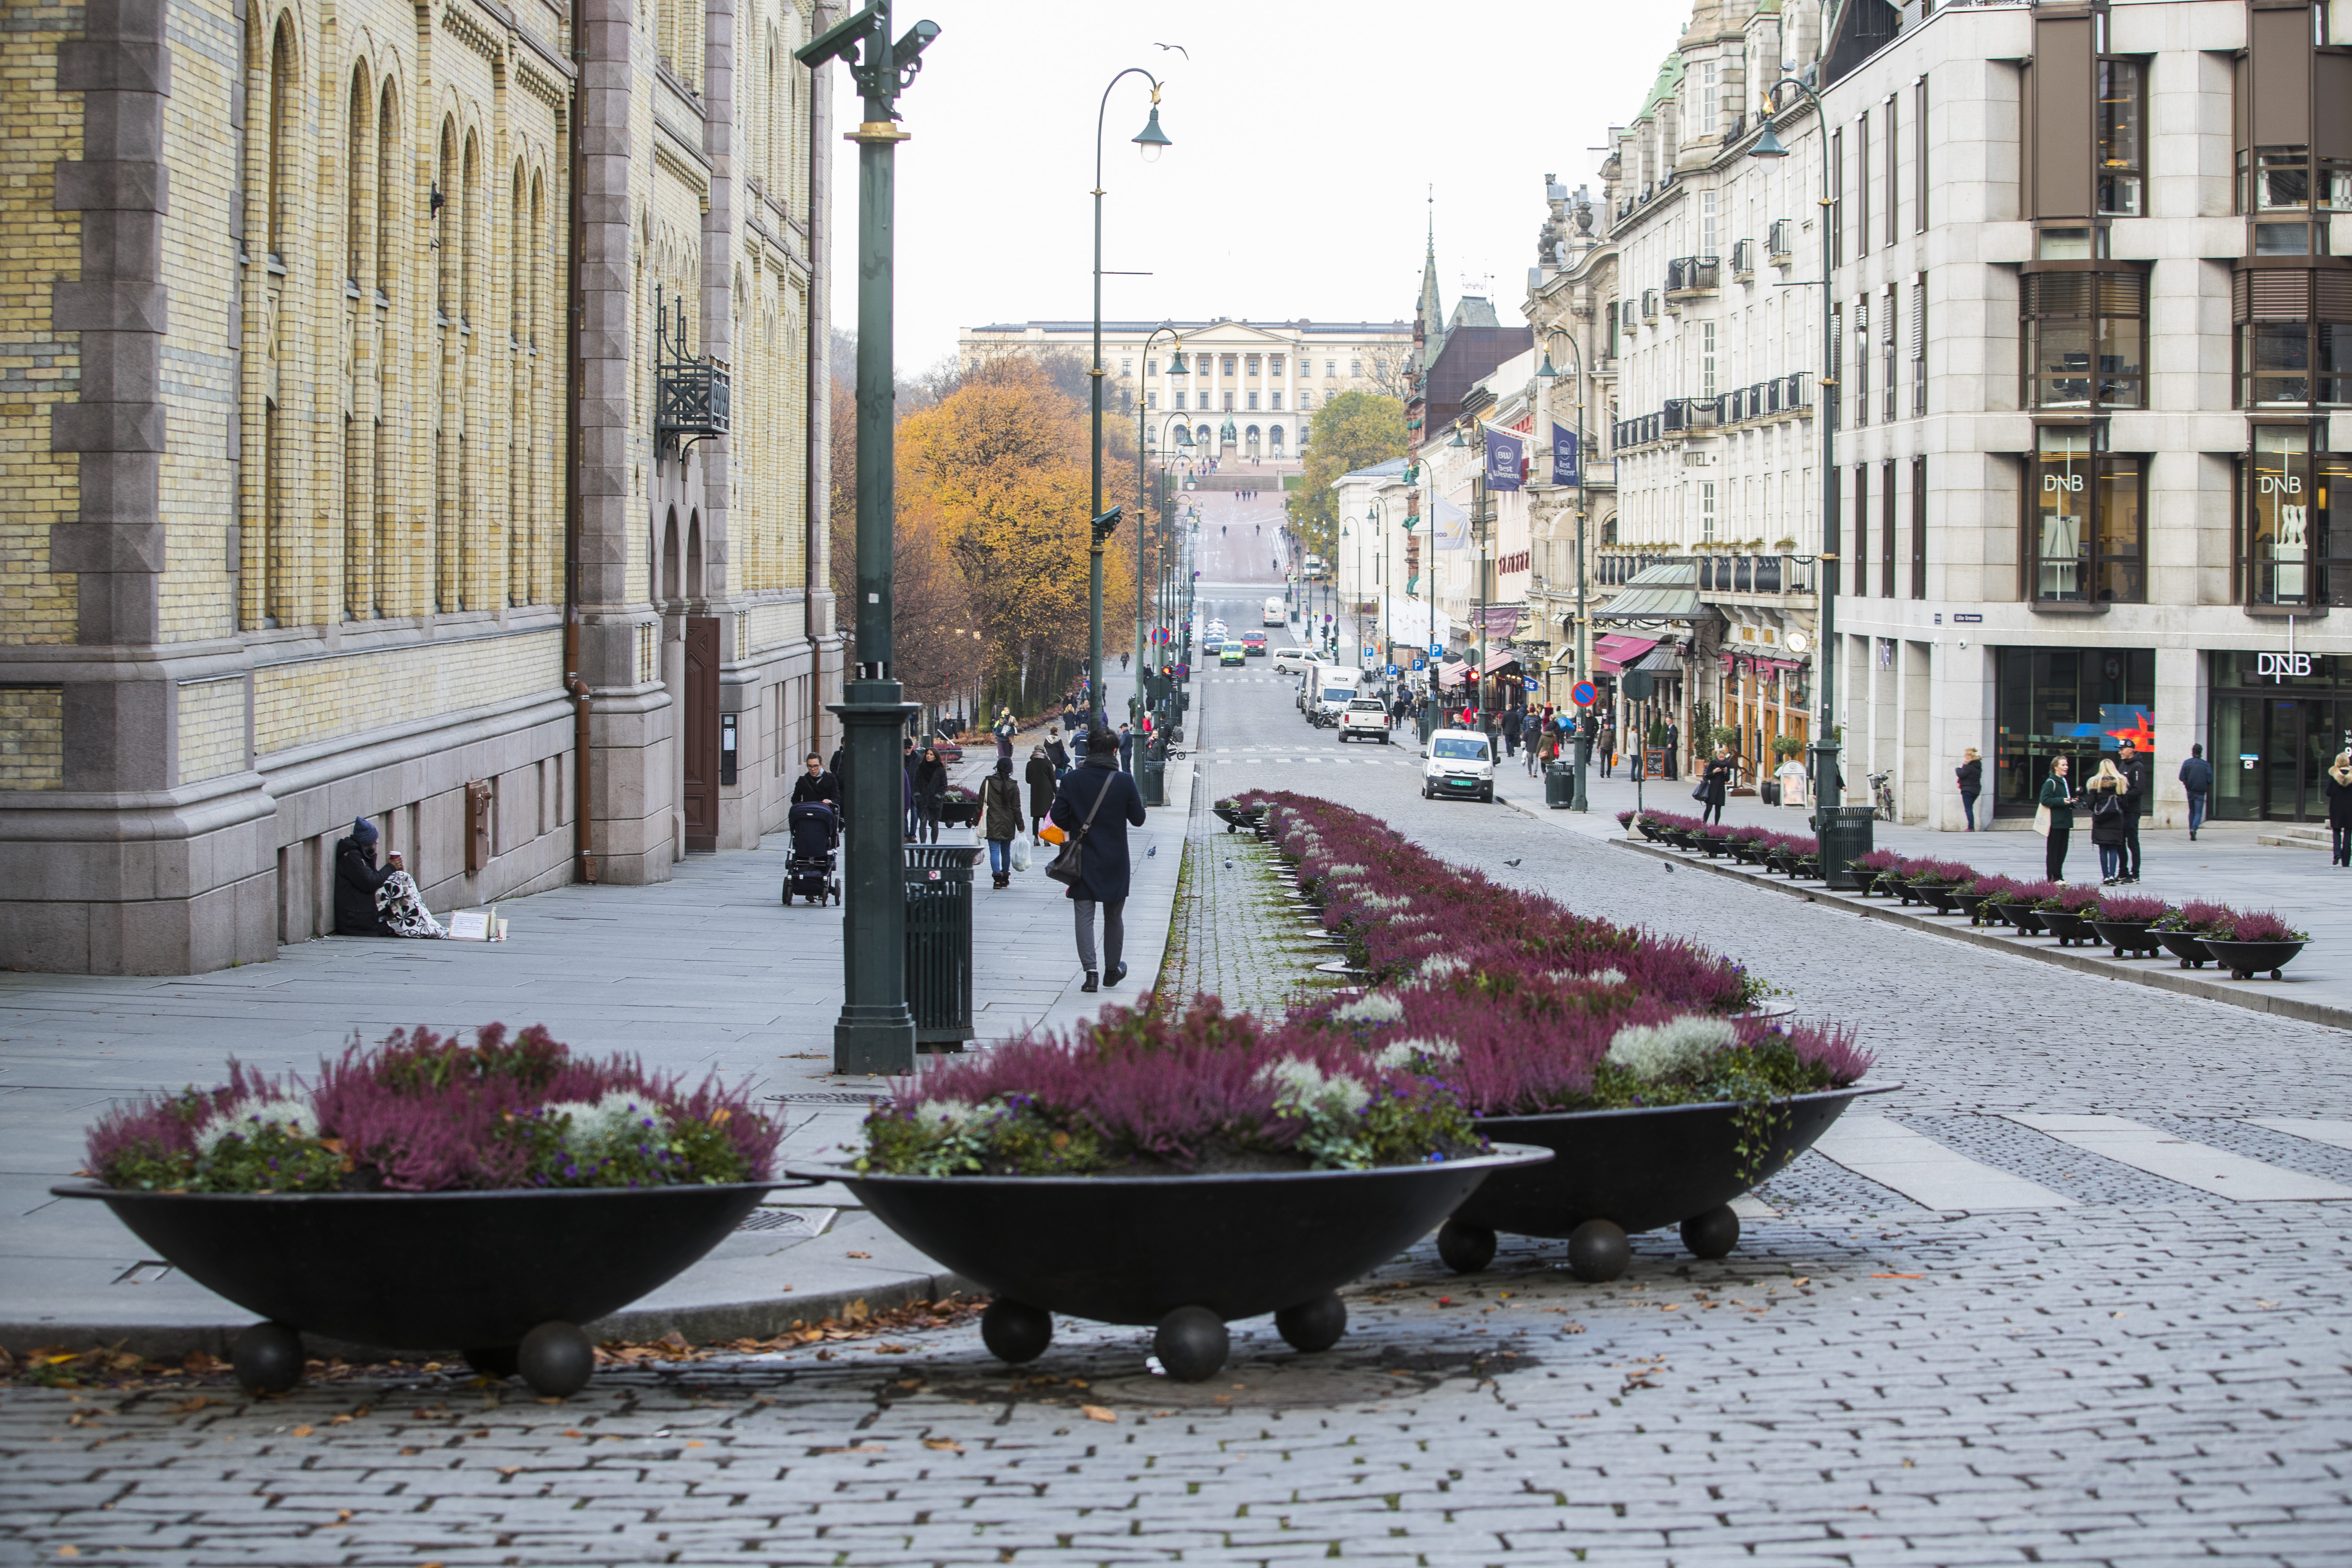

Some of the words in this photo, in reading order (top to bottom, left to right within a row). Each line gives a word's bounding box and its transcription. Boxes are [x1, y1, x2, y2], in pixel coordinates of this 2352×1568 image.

[1493, 470, 1519, 479] Western
[2044, 475, 2083, 491] DNB
[2261, 476, 2301, 493] DNB
[1432, 646, 1439, 655] P
[1415, 661, 1421, 670] P
[2258, 652, 2311, 676] DNB
[1389, 666, 1395, 674] P
